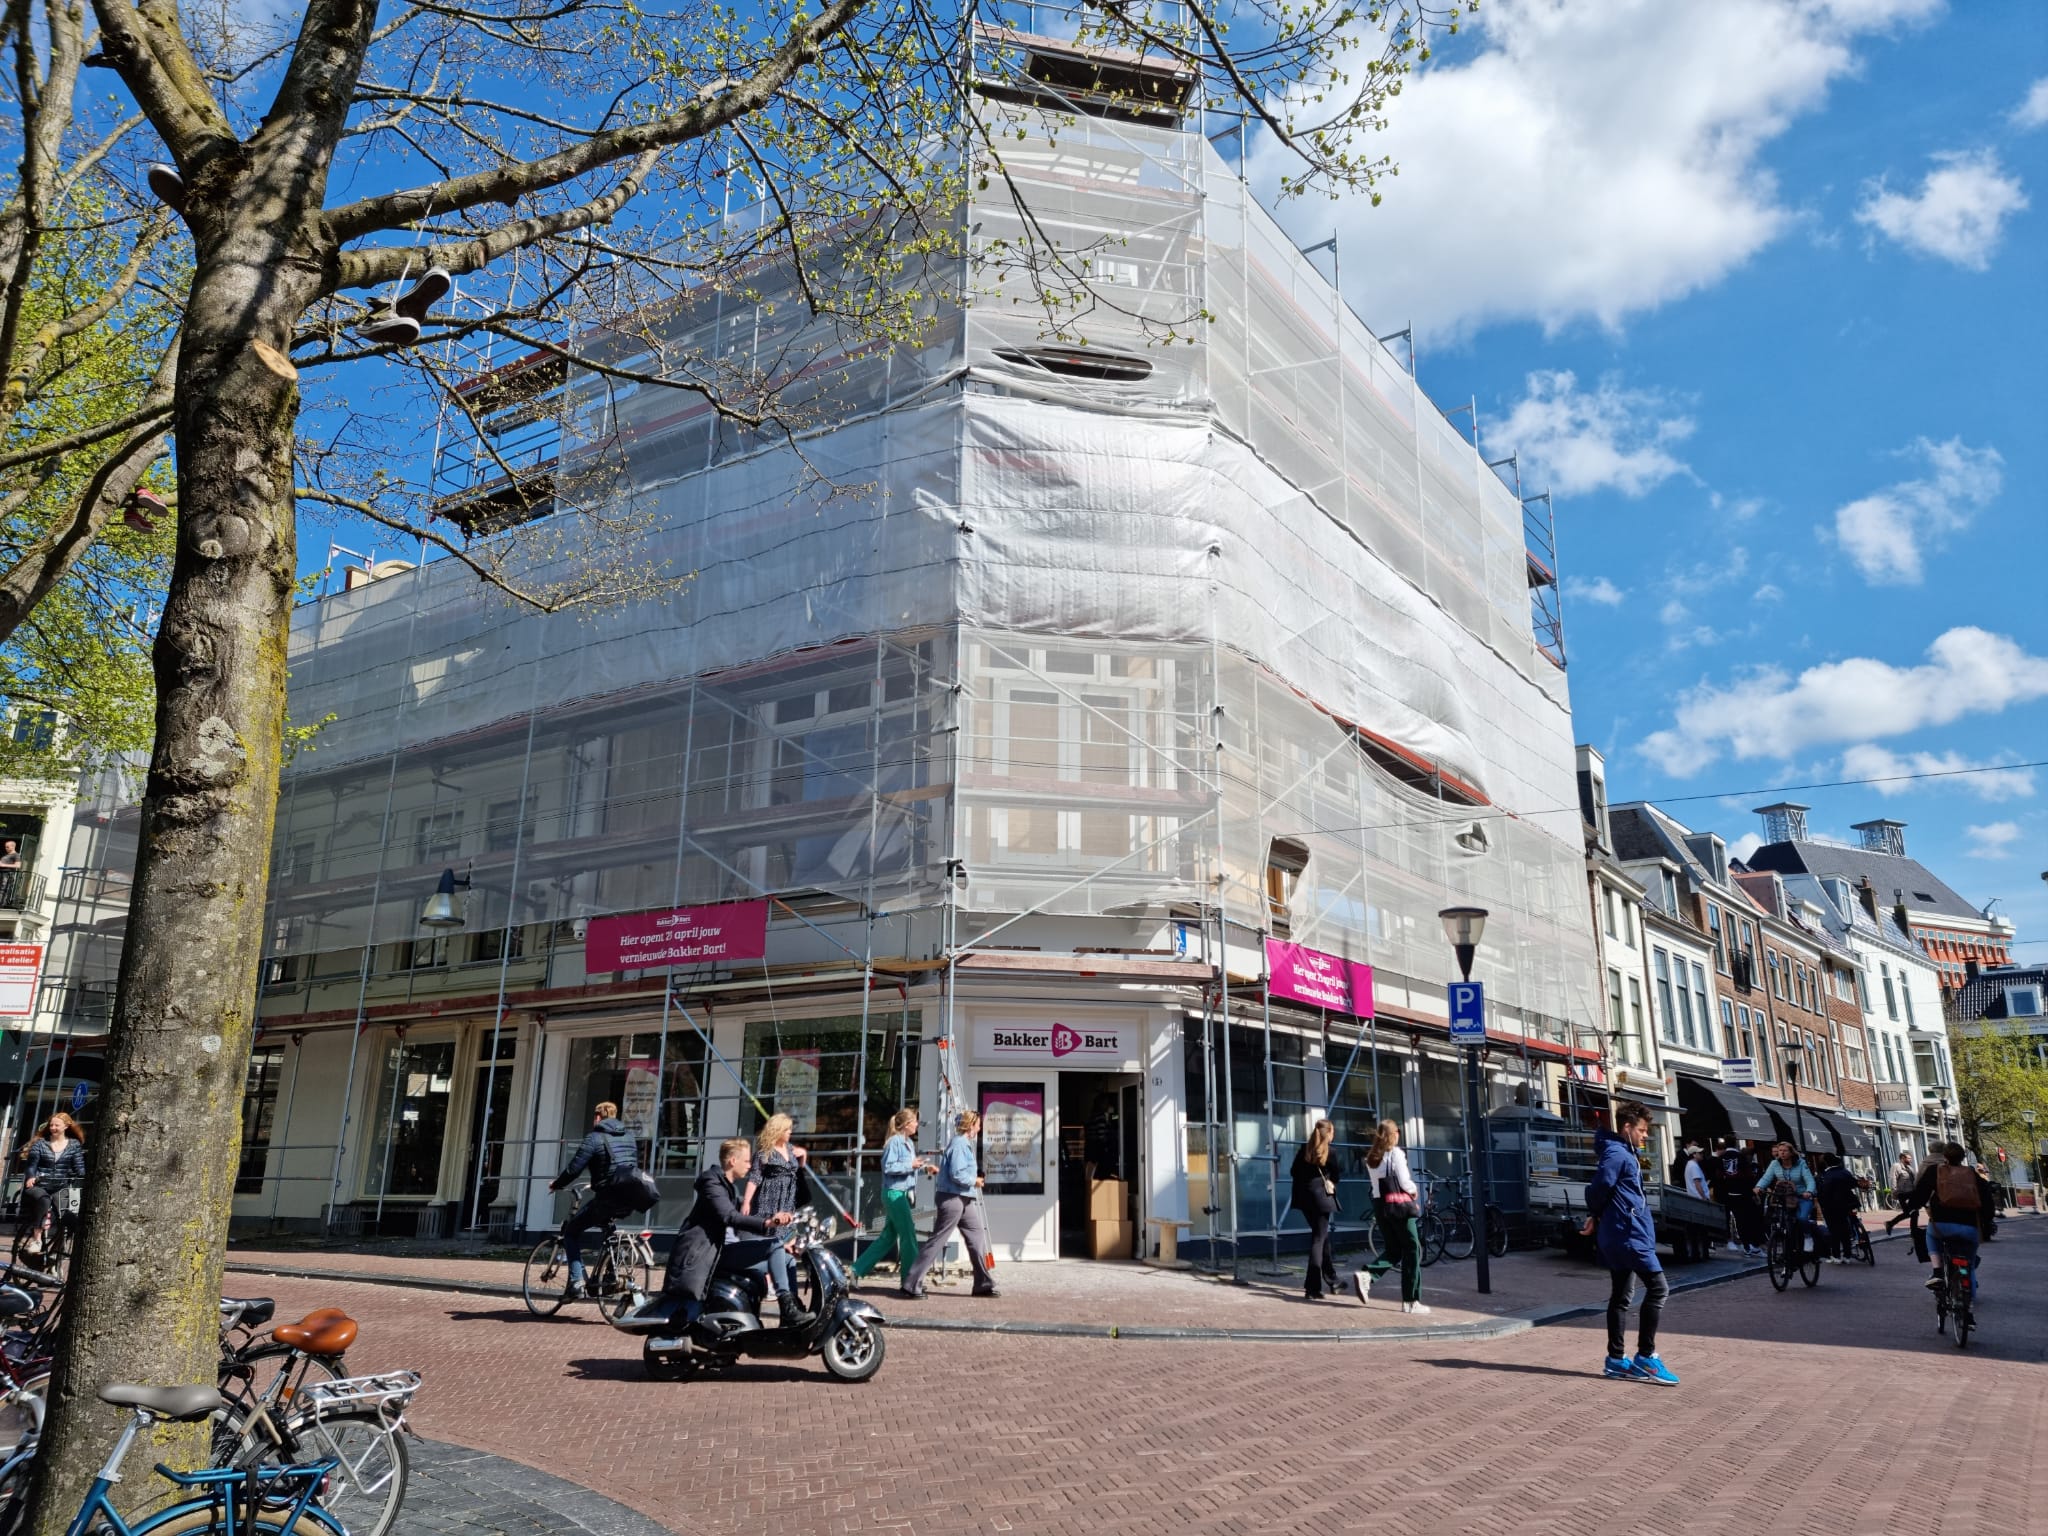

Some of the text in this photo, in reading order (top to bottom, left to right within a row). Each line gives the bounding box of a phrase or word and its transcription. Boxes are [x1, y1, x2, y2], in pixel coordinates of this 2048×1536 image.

[620, 936, 640, 946] Hier
[640, 933, 664, 946] opent
[674, 927, 699, 942] april
[699, 926, 721, 940] jouw
[667, 946, 702, 958] Bakker
[703, 943, 726, 955] Bart!
[7, 956, 34, 964] atelier
[1293, 964, 1304, 976] Hier
[1456, 987, 1475, 1013] P
[993, 1032, 1048, 1047] Bakker
[1085, 1035, 1118, 1049] Bart
